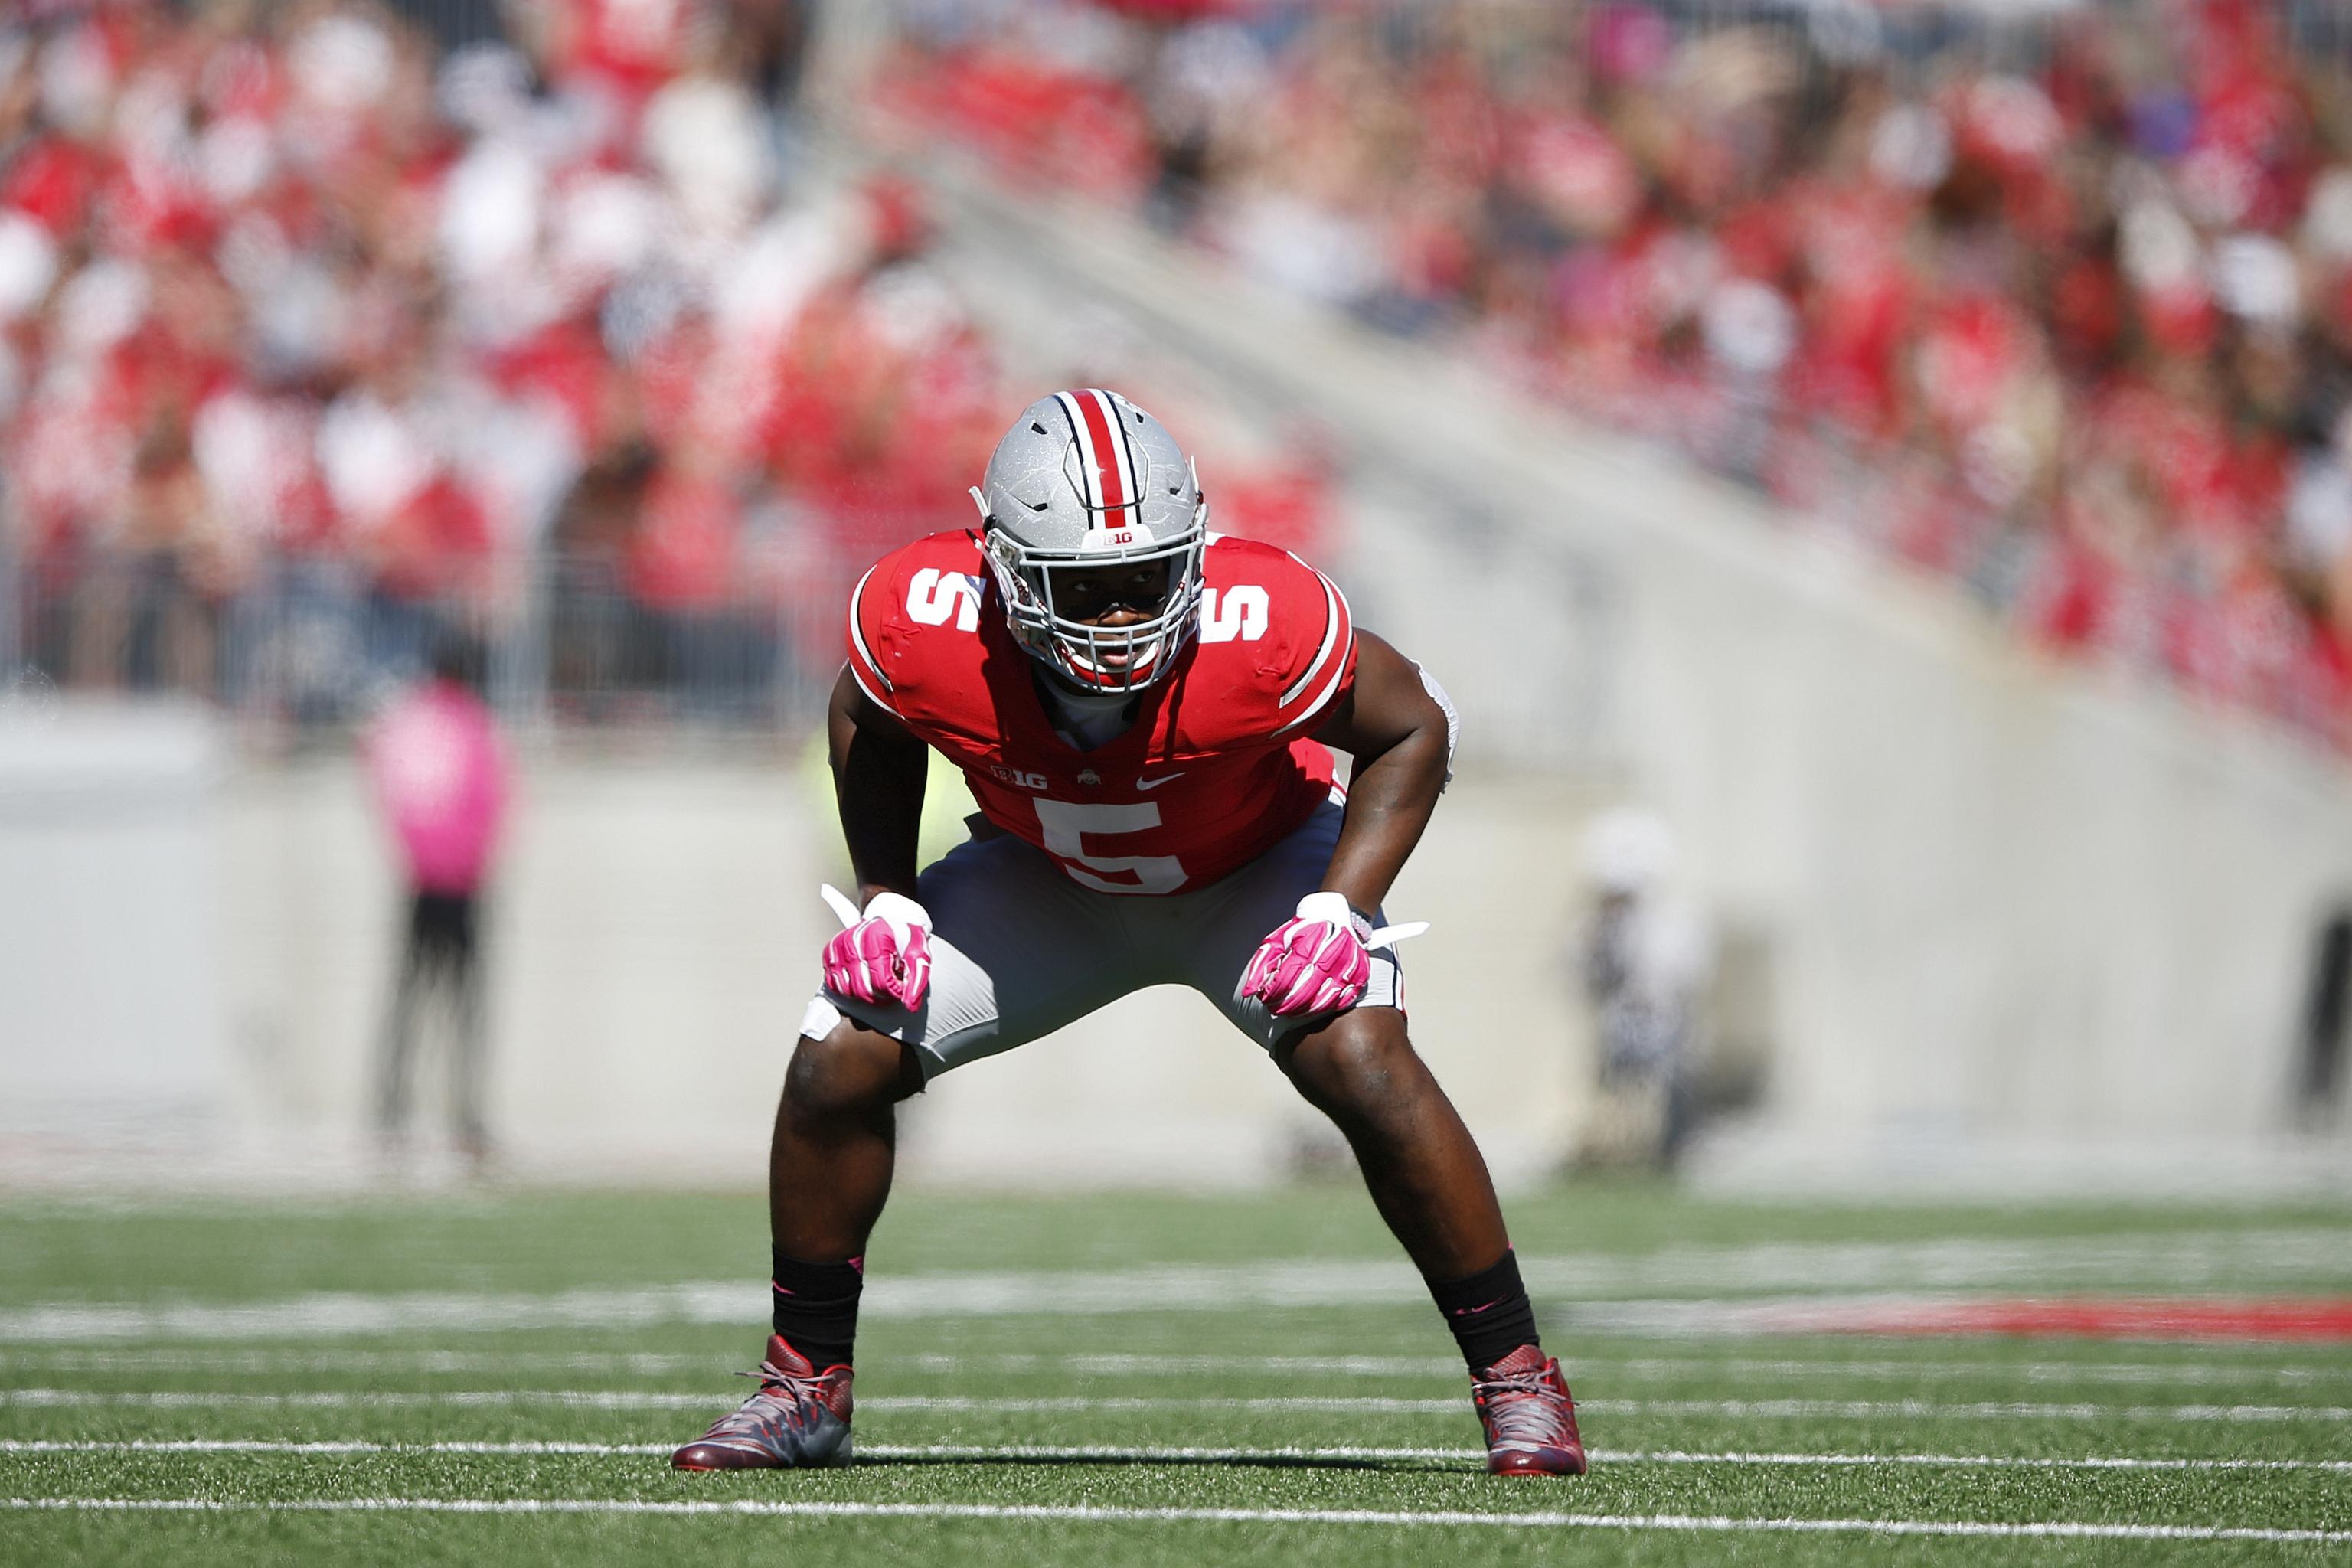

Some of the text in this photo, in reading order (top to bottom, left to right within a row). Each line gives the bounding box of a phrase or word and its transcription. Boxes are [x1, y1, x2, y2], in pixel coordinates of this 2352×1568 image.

[906, 567, 987, 632] 5
[1198, 585, 1269, 643] 5
[1032, 796, 1189, 894] 5
